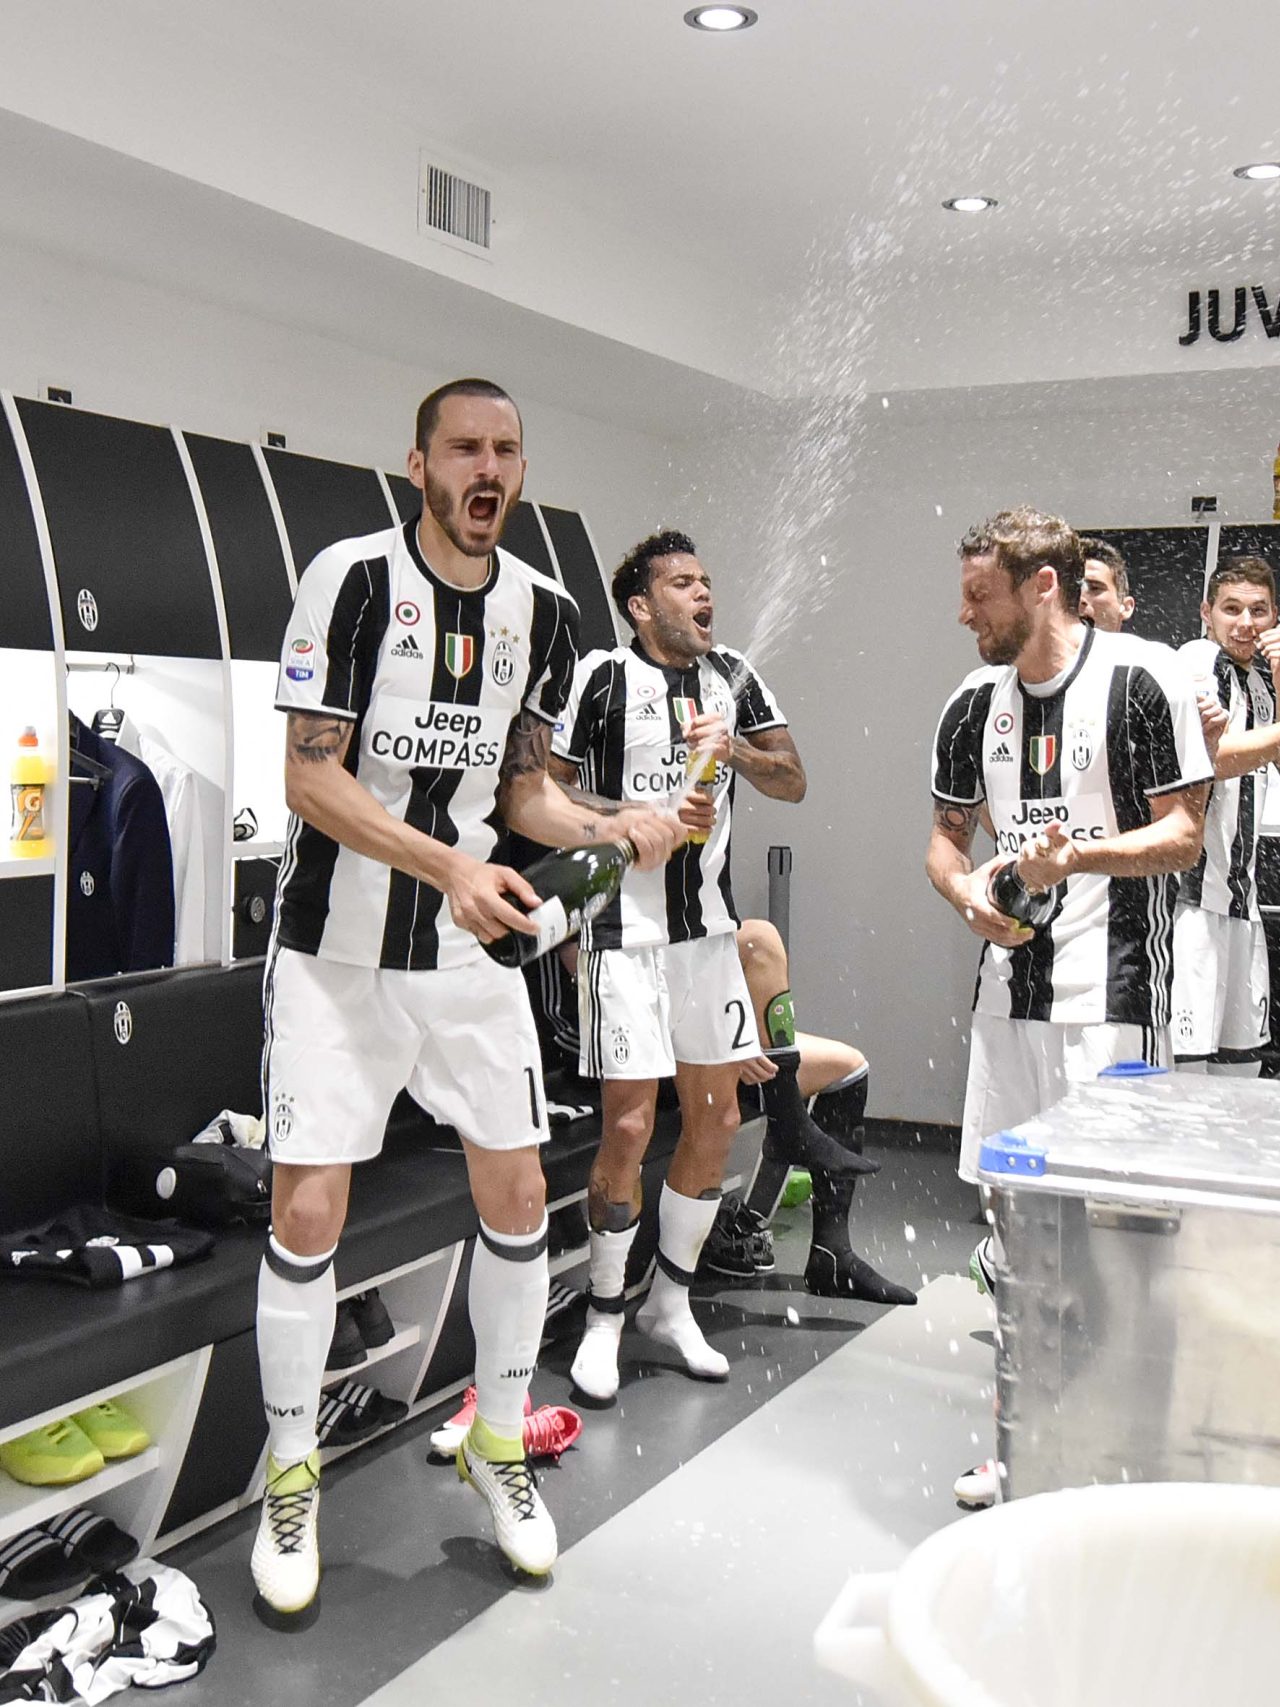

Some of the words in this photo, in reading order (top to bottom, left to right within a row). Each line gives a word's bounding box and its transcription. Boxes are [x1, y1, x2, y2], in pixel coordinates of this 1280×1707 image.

[391, 648, 424, 660] adidas
[414, 703, 482, 739] Jeep
[371, 730, 499, 768] COMPASS
[661, 746, 688, 767] Je
[633, 764, 728, 793] COMSS
[25, 791, 41, 811] G
[1011, 801, 1069, 826] Jeep
[724, 999, 754, 1050] 2
[523, 1066, 541, 1130] 1
